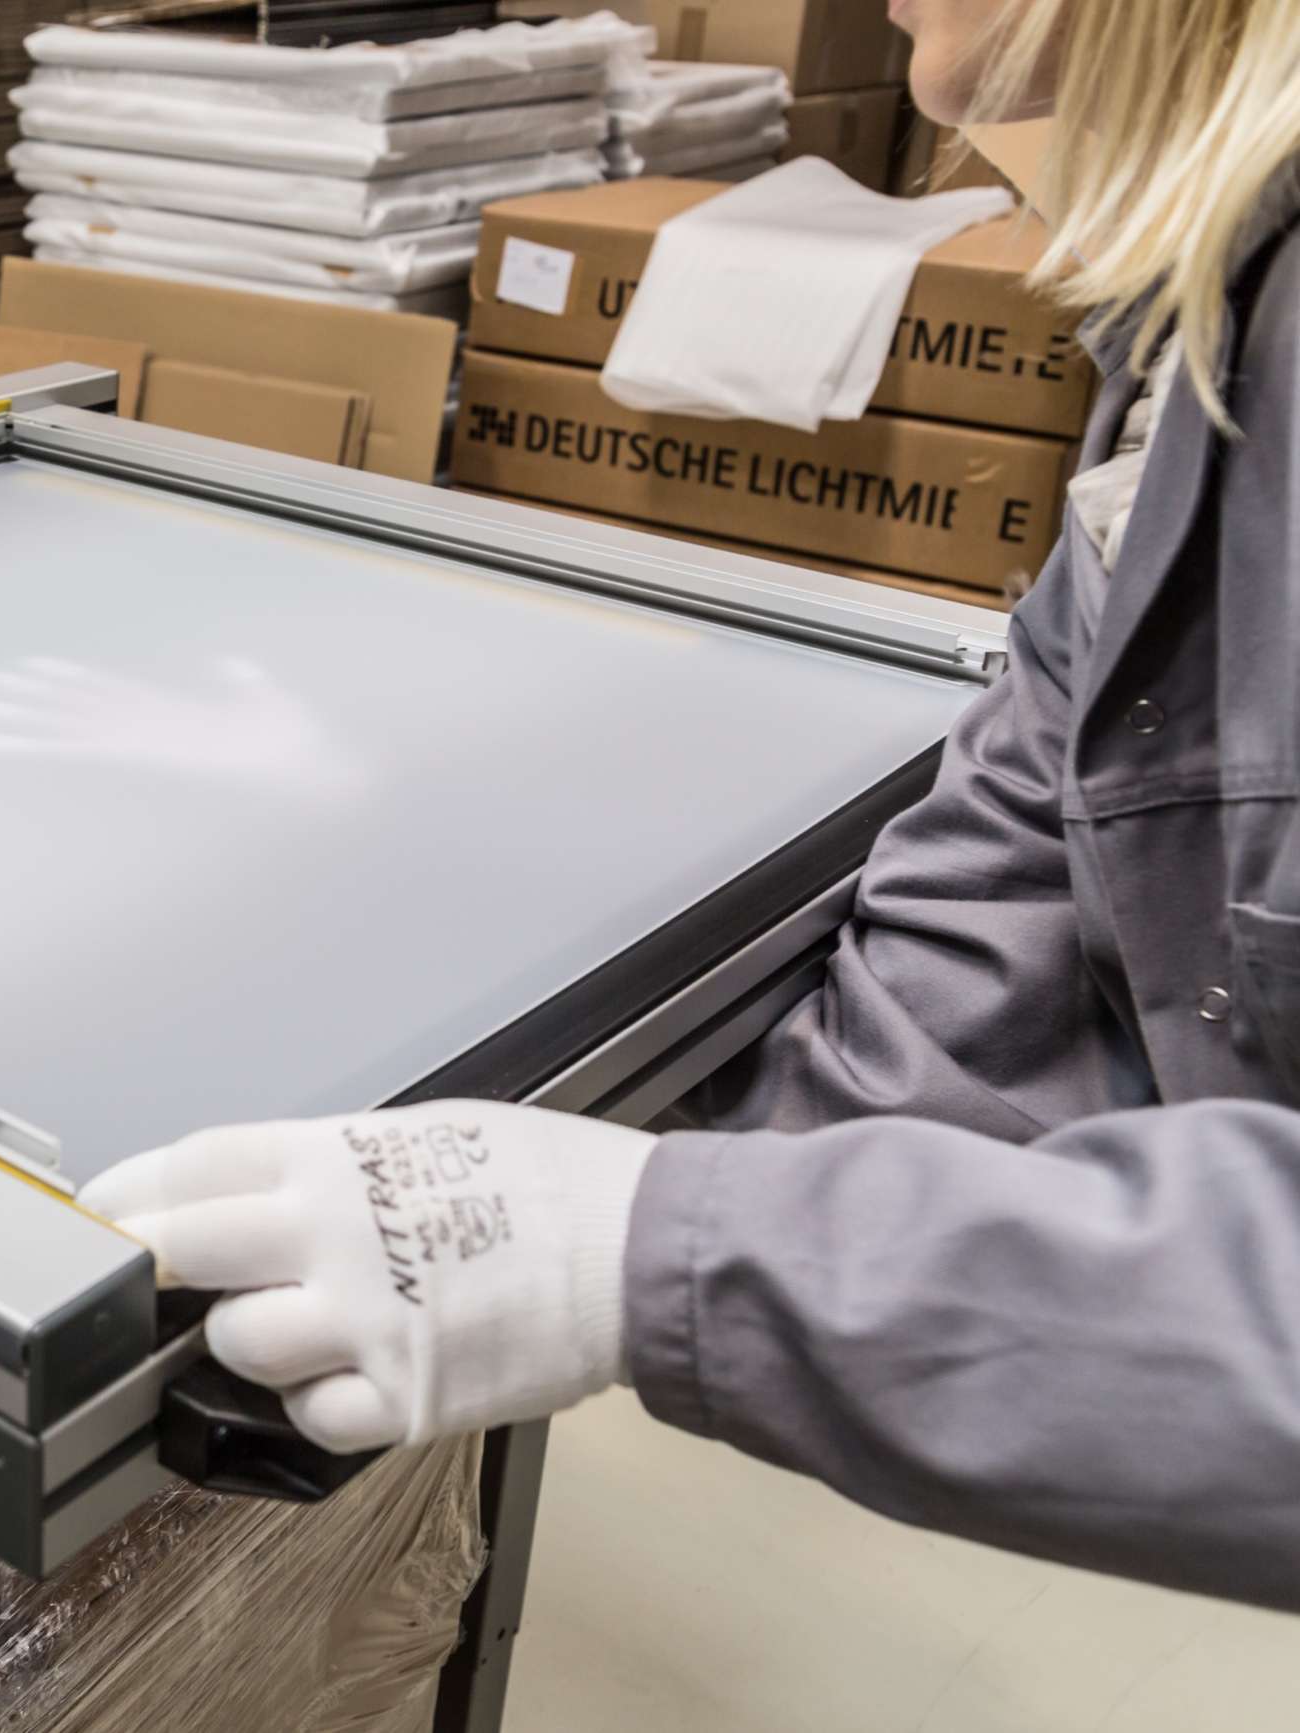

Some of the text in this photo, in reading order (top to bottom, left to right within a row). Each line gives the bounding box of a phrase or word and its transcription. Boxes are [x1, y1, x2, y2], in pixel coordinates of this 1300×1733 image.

[888, 315, 1071, 382] TMIEE
[524, 413, 1032, 544] DEUTSCHE LICHTMIEE
[349, 1136, 424, 1305] NITRAS
